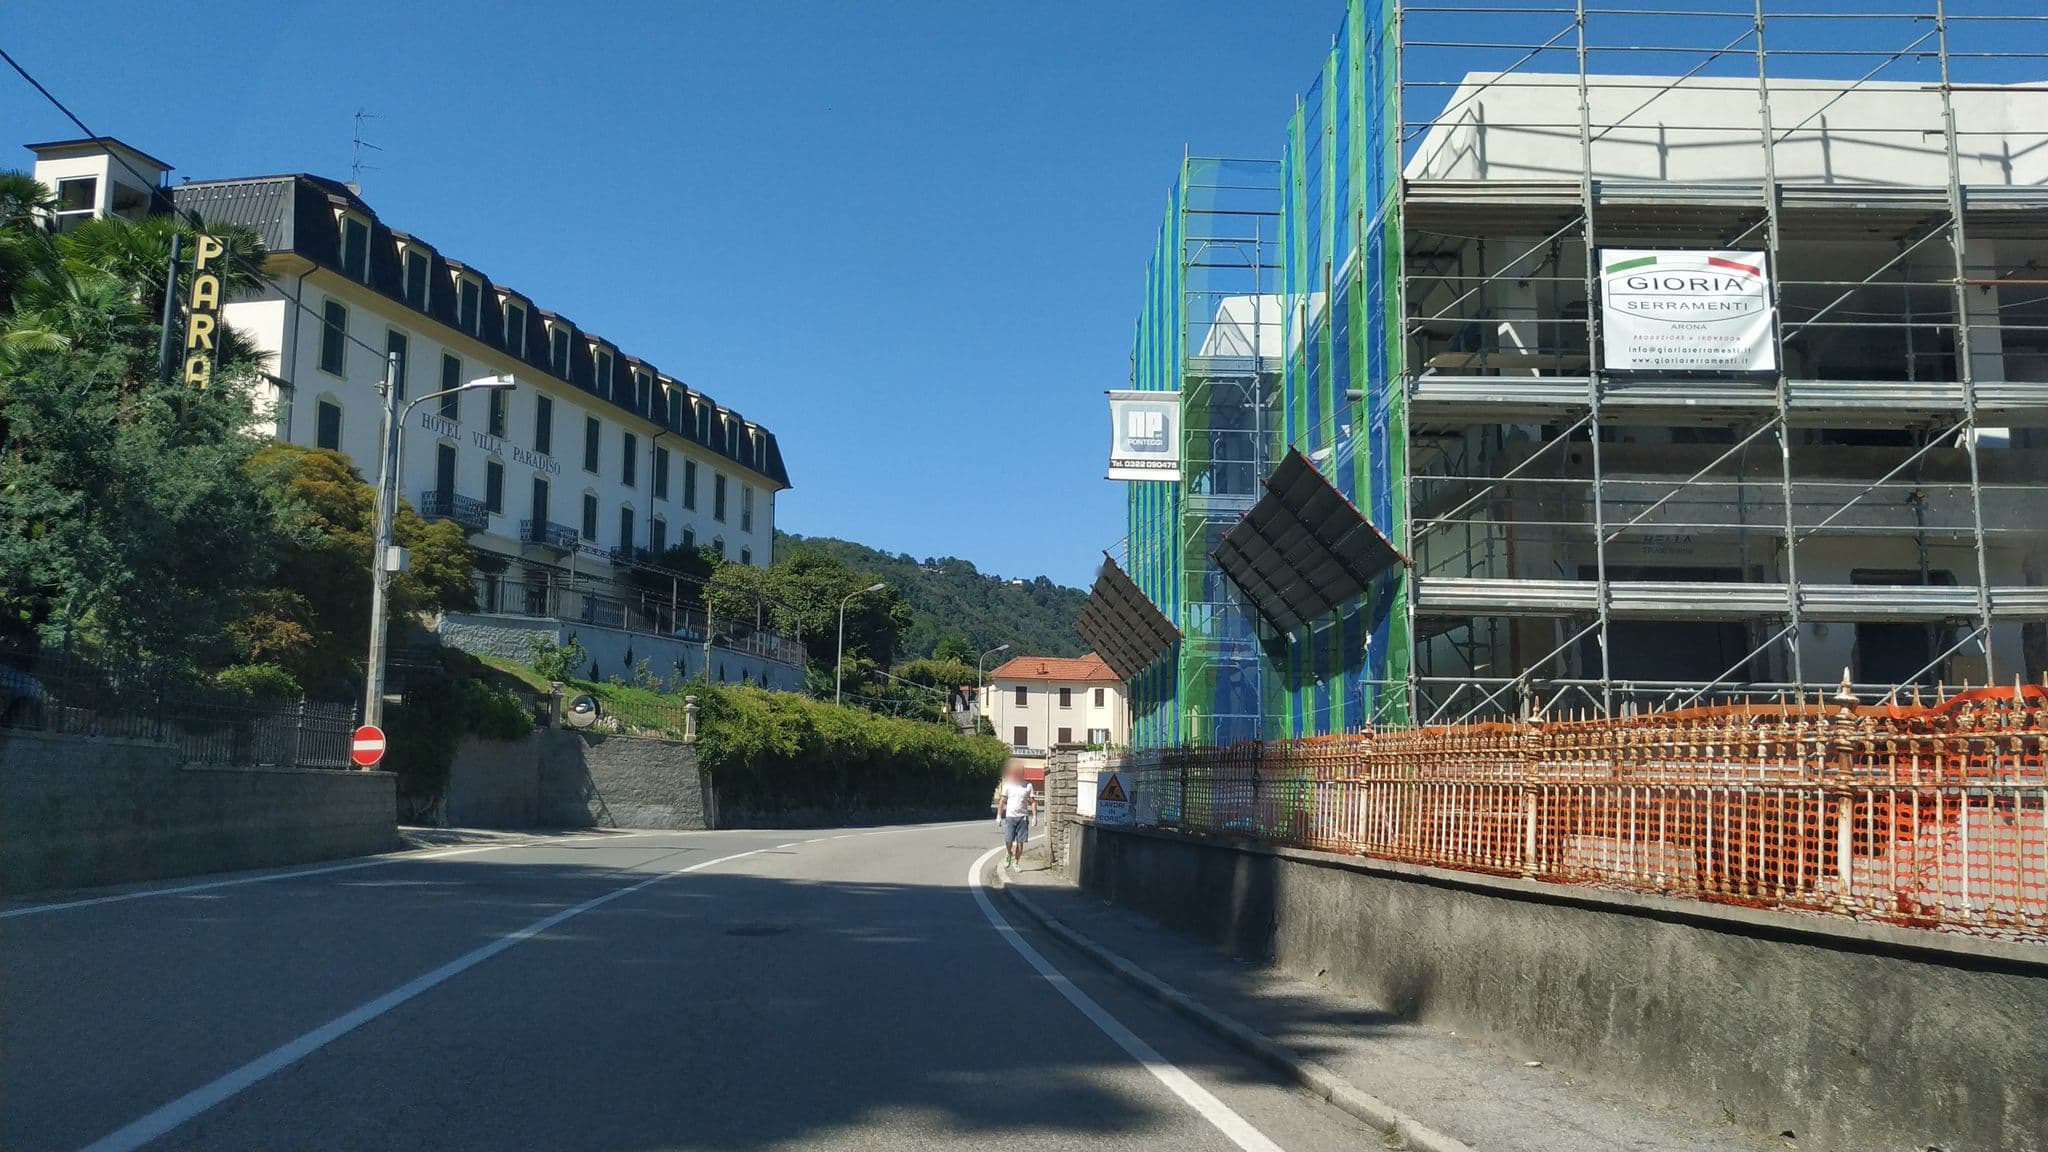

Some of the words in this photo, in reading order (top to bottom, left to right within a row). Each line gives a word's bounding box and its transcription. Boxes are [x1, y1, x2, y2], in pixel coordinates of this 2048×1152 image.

[1627, 276, 1744, 291] GIORIA
[1627, 301, 1748, 311] SERRAMENTI
[185, 236, 223, 389] PARA
[1628, 346, 1751, 355] info@gioriaserramenti.it
[1632, 357, 1748, 365] www.gioriaserramenti.it
[421, 412, 461, 440] HOTEL
[472, 431, 503, 456] VILLA
[513, 446, 561, 476] PARADISO
[1124, 460, 1145, 468] 0322
[1100, 801, 1126, 809] LAVORI
